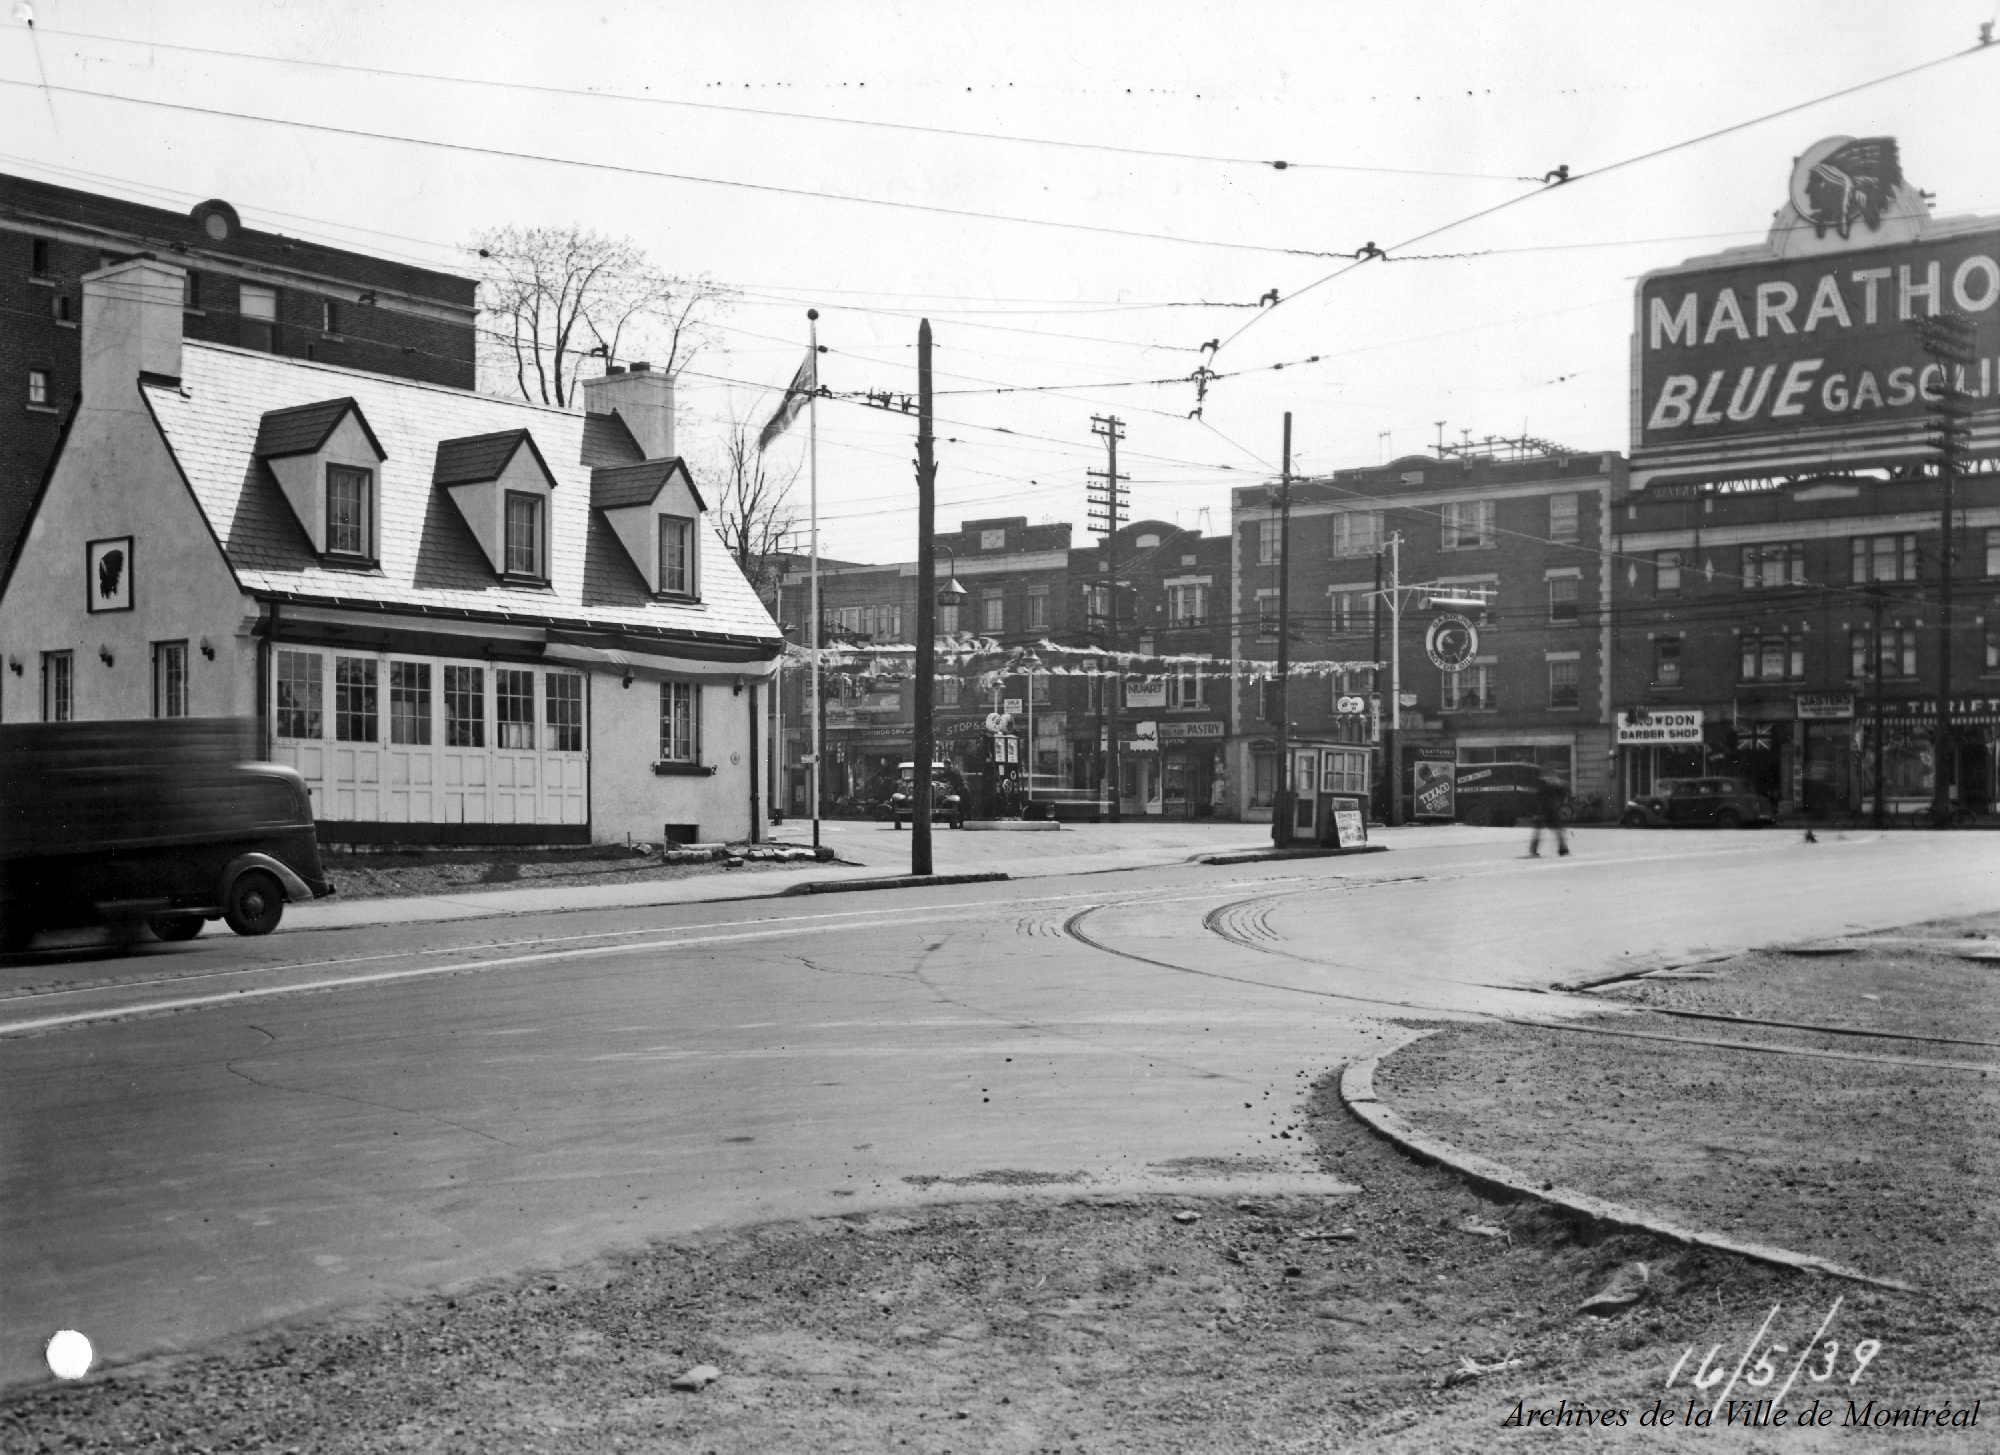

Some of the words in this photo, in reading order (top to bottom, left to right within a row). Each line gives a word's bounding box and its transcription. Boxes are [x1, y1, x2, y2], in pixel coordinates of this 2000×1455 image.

[1651, 254, 2000, 350] MARATHO
[1647, 358, 1824, 430] BLUE
[1822, 357, 2000, 412] GASOLI
[1432, 613, 1474, 629] GASOLINE
[1429, 649, 1457, 670] MOTOR
[1458, 652, 1475, 670] OILS
[946, 722, 973, 736] STOP
[1187, 723, 1221, 735] PASTRY
[1621, 730, 1665, 739] BARBER
[1669, 728, 1699, 738] SHOP
[1420, 782, 1450, 803] TEXACO
